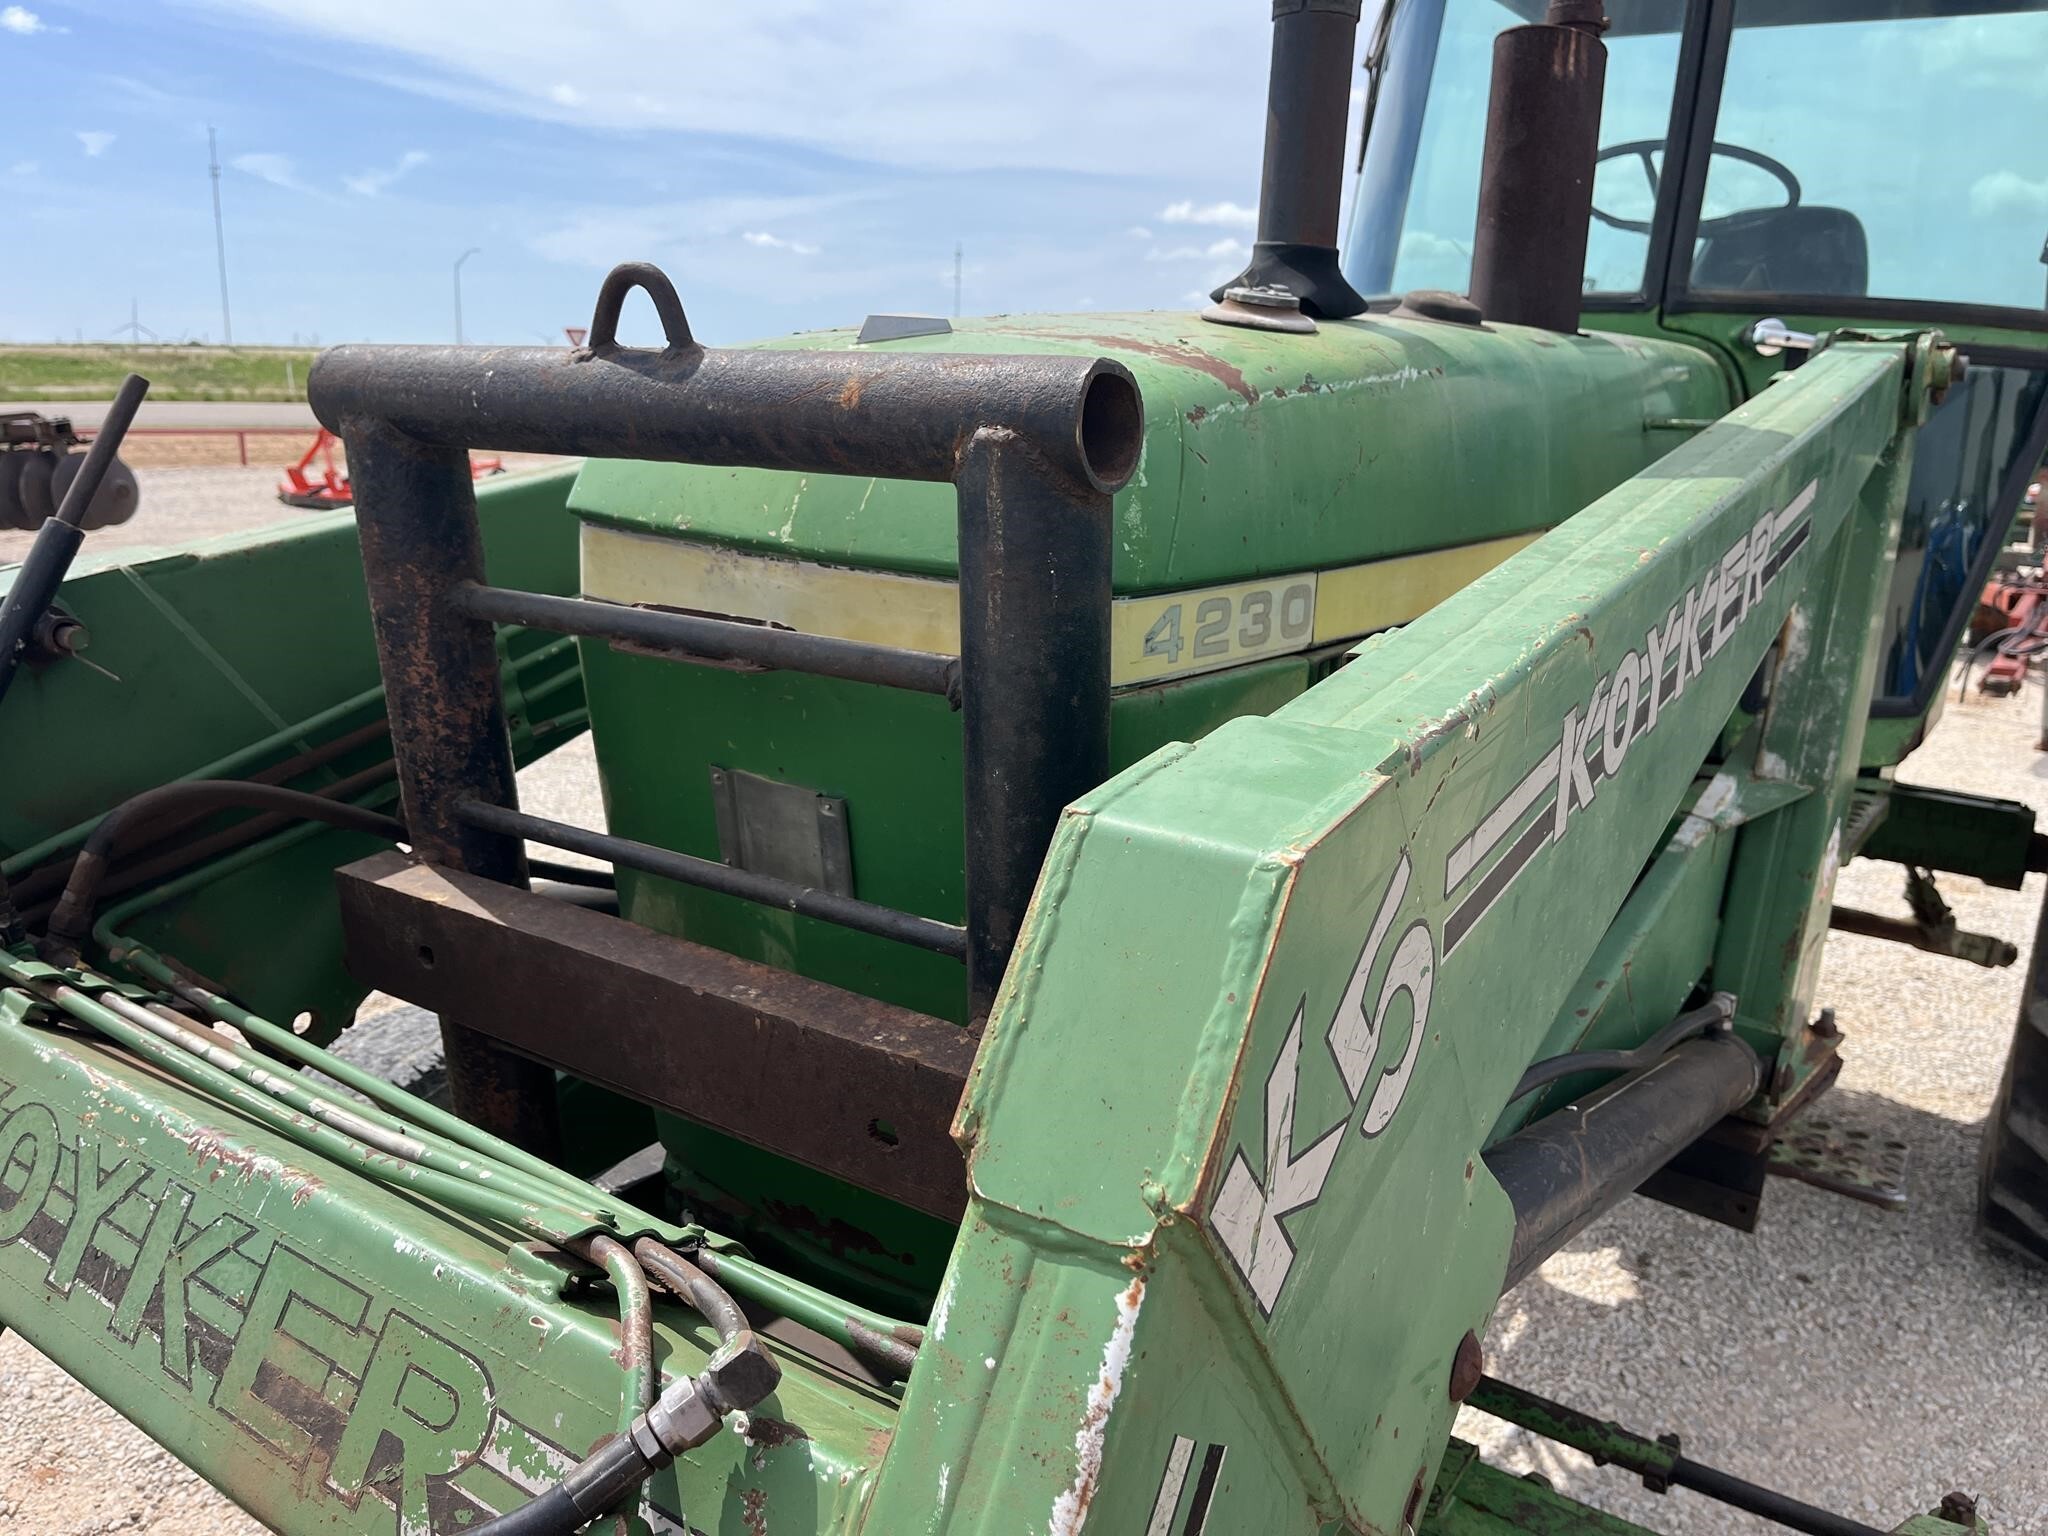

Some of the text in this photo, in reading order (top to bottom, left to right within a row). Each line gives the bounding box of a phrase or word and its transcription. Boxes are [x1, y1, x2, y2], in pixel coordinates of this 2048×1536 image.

[1143, 584, 1312, 664] 4230
[1552, 509, 1775, 848] KOYKER
[1209, 846, 1436, 1323] K5
[0, 1078, 497, 1536] OYKER
